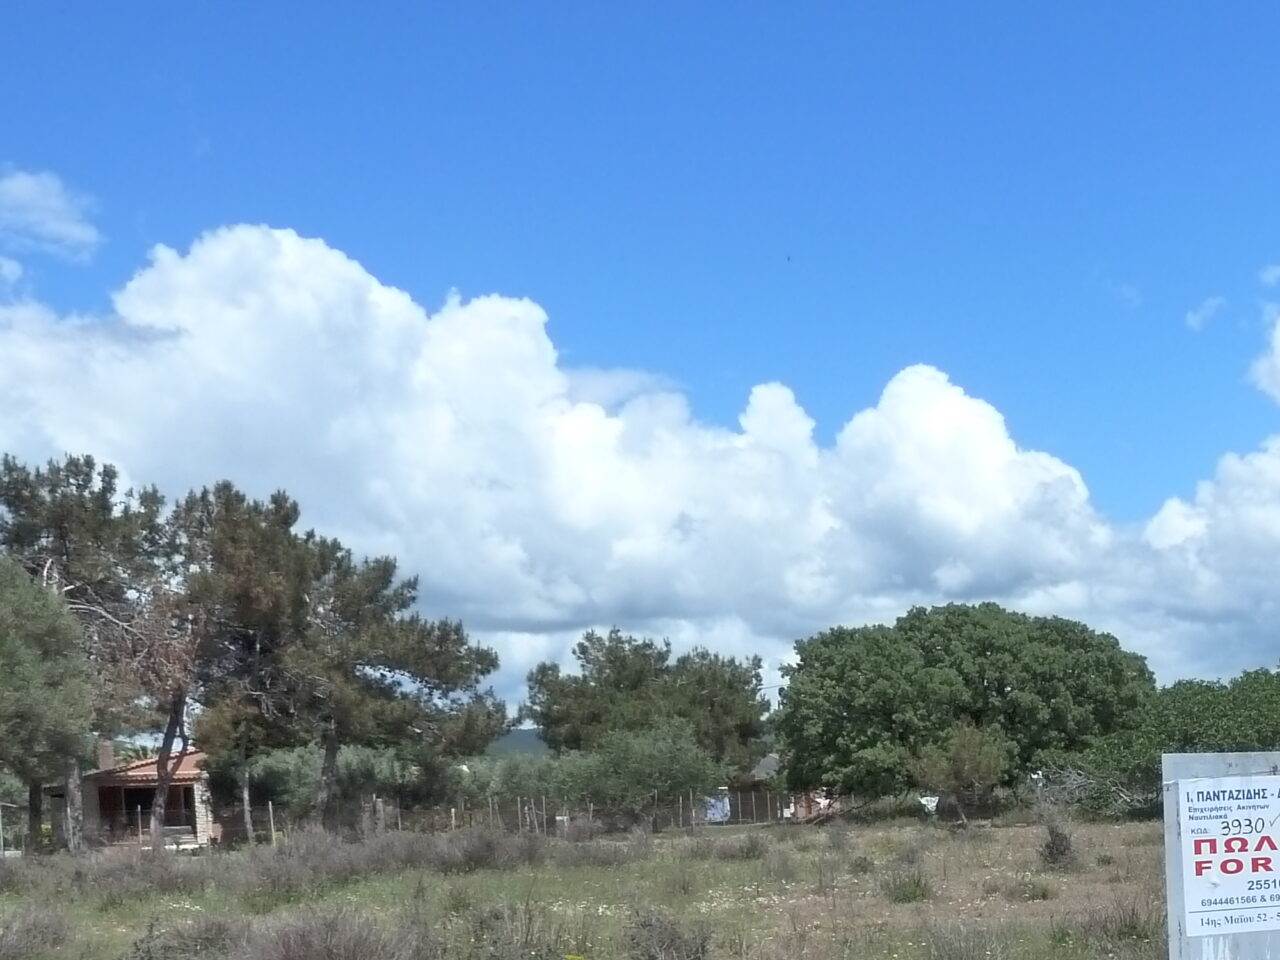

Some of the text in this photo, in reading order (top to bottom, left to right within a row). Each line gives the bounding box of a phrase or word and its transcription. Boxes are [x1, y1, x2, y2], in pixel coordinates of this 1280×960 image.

[1197, 789, 1268, 802] ΠΑΝΤΑΖΙΔΗΣ
[1220, 817, 1265, 836] 3930
[1195, 857, 1274, 876] FOR
[1201, 895, 1258, 907] 6944461566
[1260, 895, 1267, 903] &
[1257, 913, 1267, 922] 52
